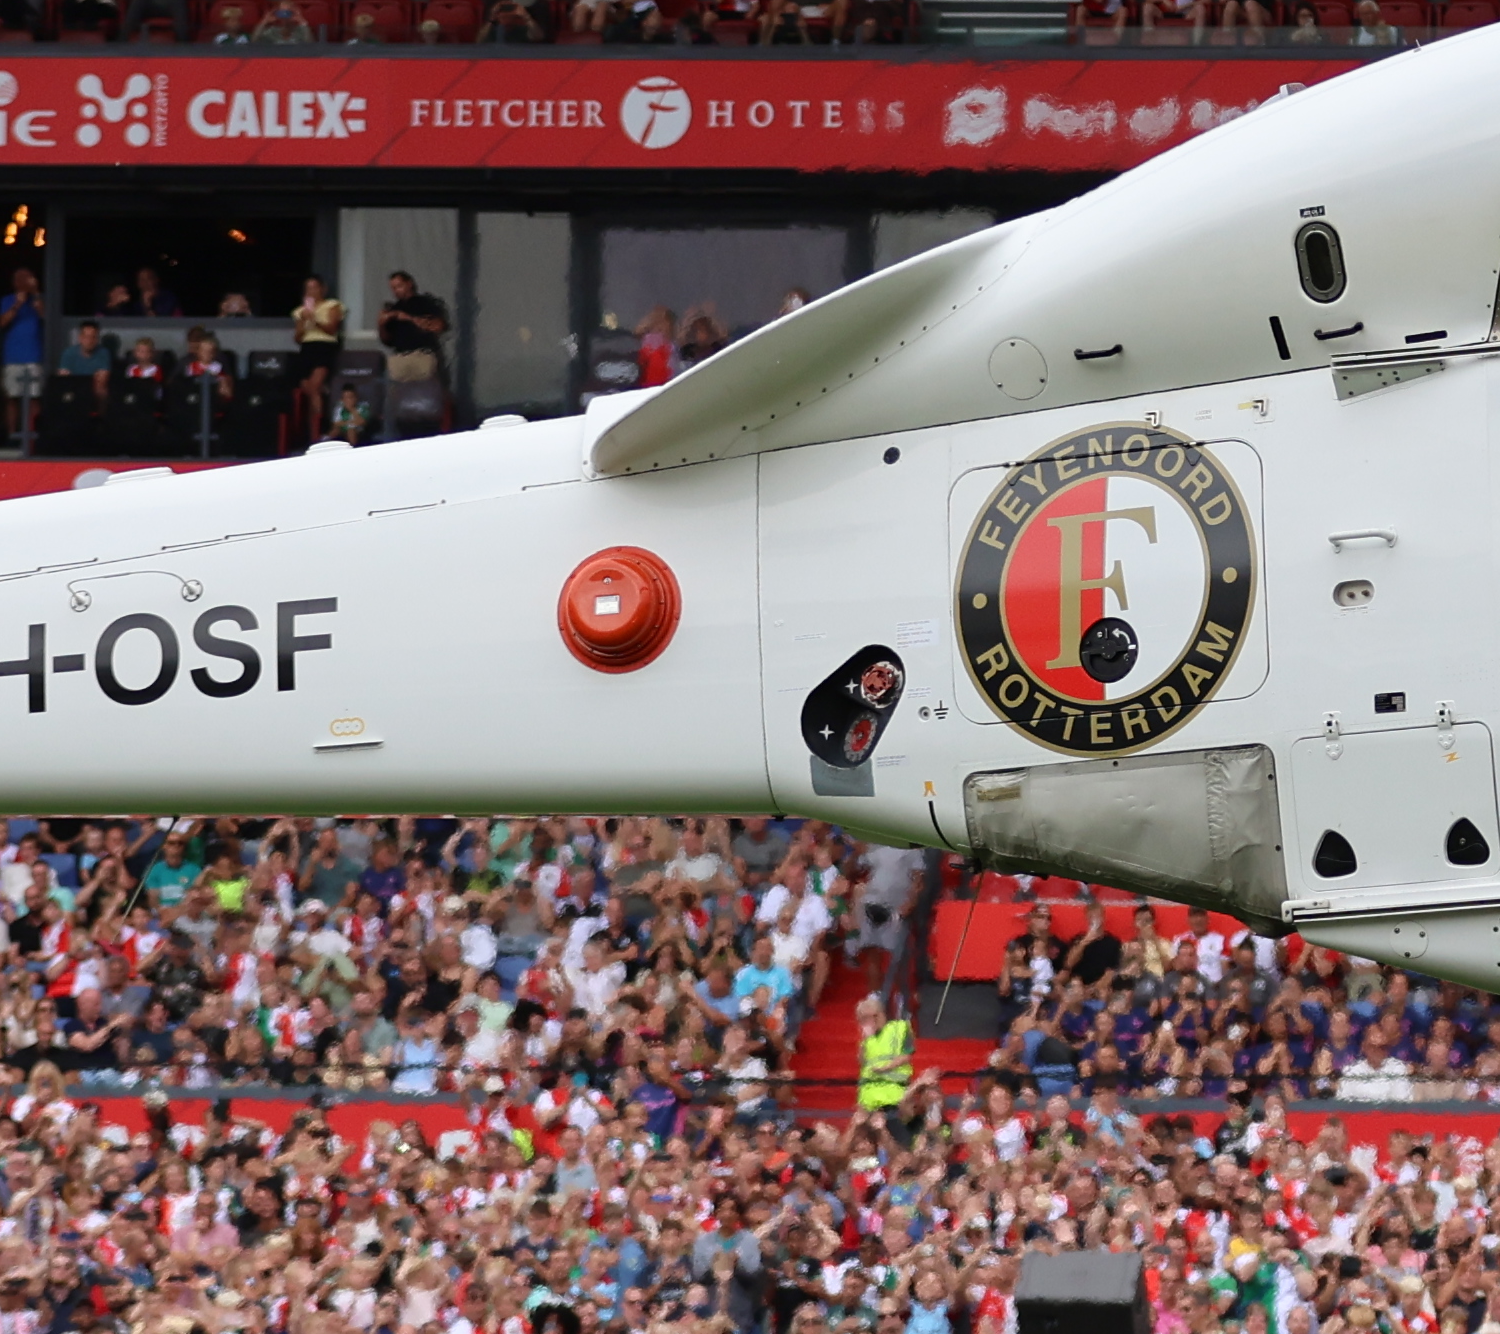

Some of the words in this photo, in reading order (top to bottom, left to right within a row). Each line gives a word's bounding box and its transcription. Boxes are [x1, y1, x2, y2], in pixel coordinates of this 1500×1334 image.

[186, 90, 351, 139] CALEX
[410, 99, 605, 128] FLETCHER
[979, 434, 1233, 551] FEYENOORD
[975, 619, 1235, 745] ROTTERDAM
